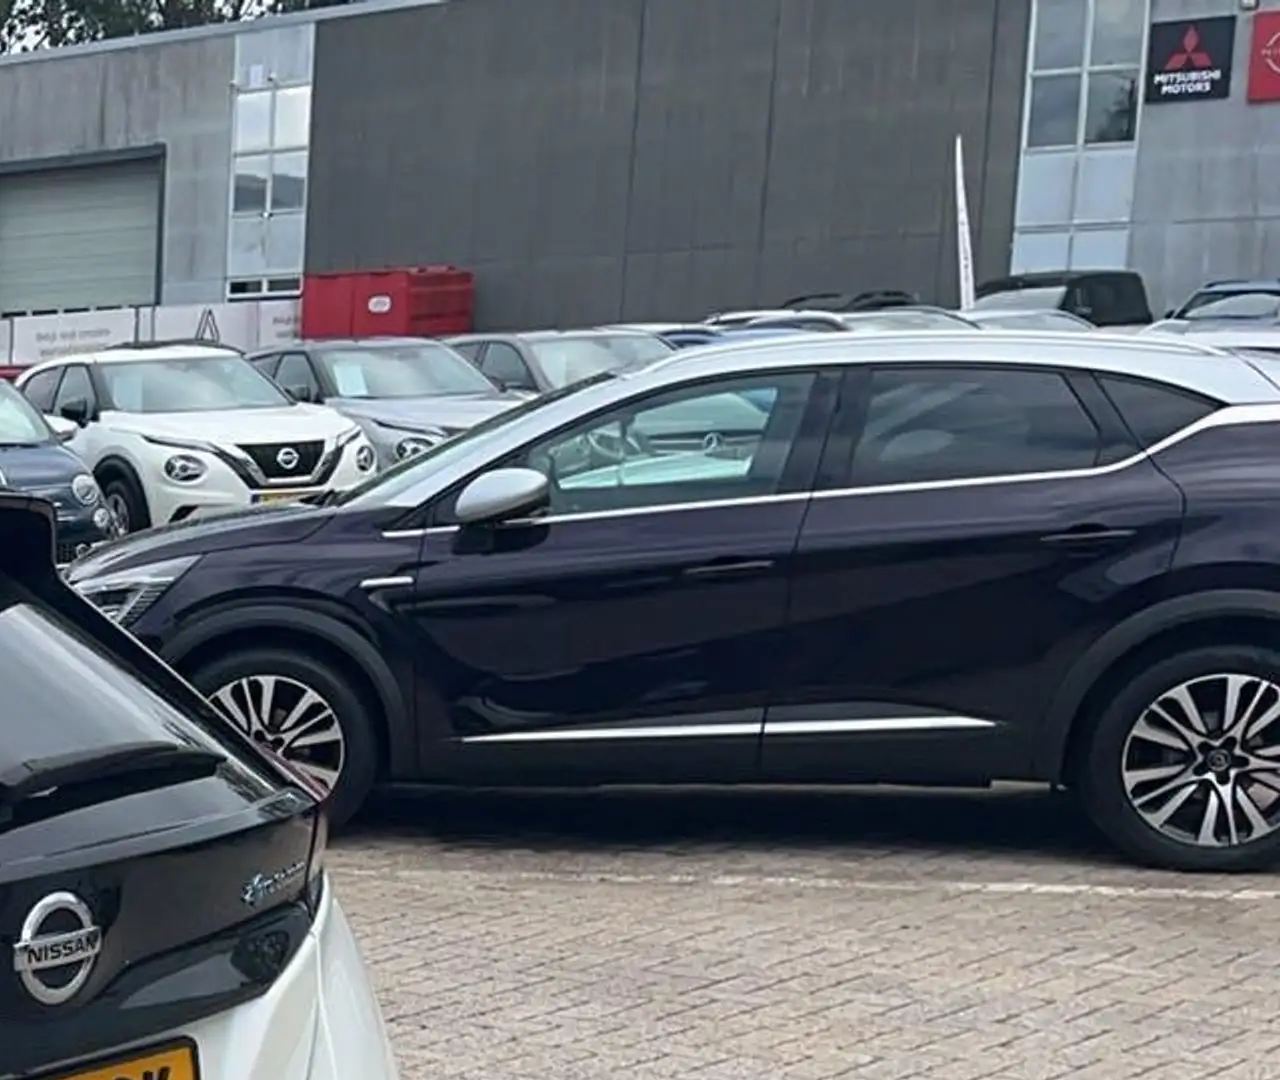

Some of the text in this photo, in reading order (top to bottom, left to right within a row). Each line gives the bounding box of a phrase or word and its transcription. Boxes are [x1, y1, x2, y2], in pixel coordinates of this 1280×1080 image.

[1154, 69, 1221, 85] MITSUBISHI
[1161, 81, 1211, 95] MOTORS
[26, 935, 98, 964] NISSAN
